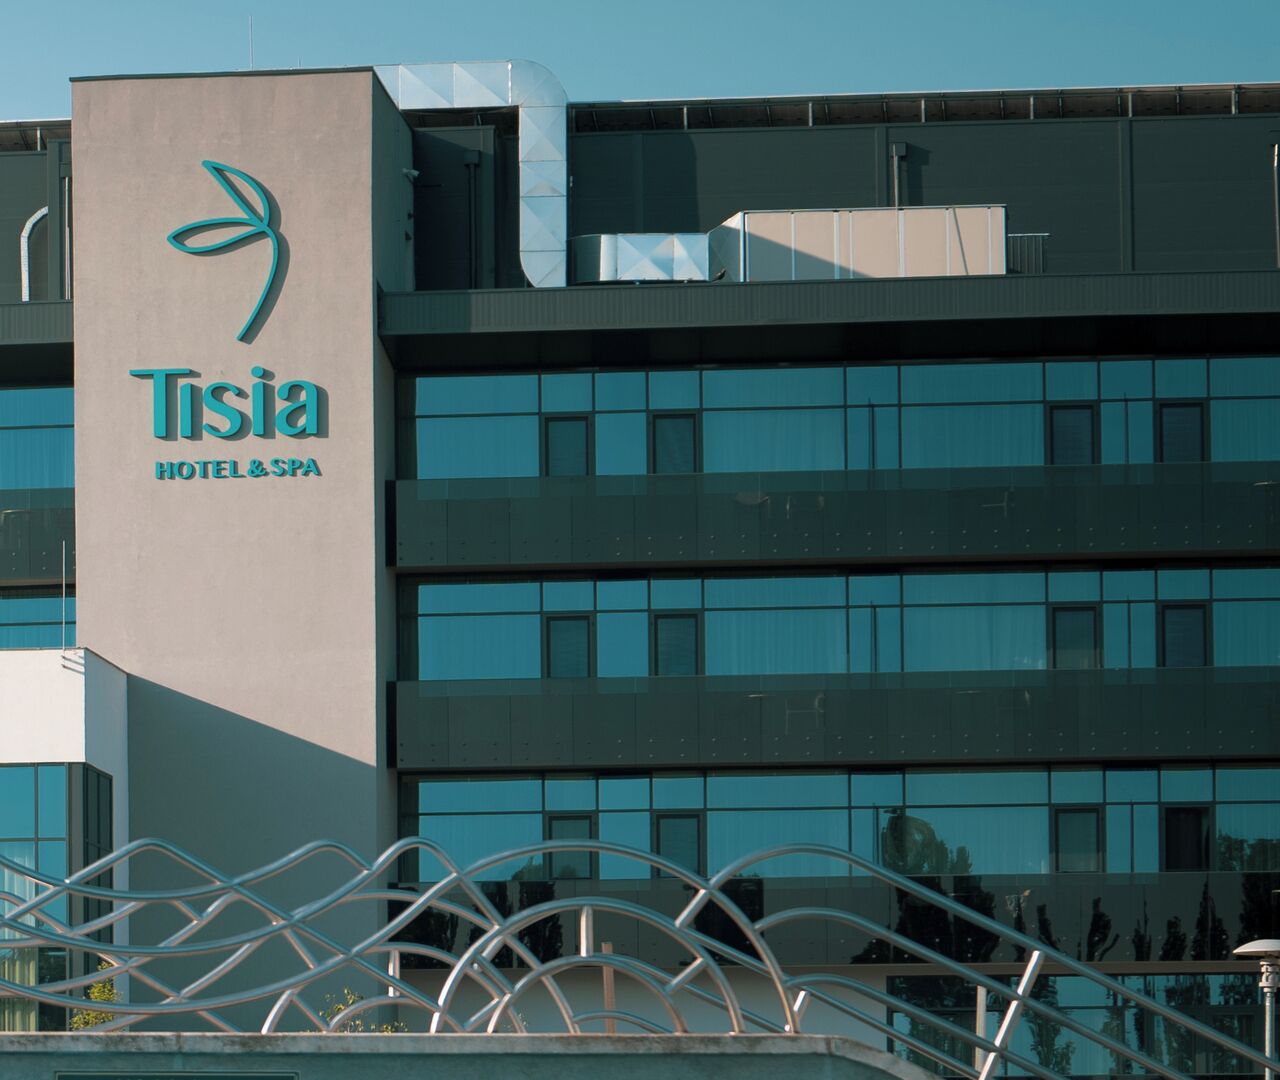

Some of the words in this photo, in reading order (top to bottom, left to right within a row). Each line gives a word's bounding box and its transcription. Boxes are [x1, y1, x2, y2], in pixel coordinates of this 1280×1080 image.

[129, 365, 320, 438] Tisia
[155, 459, 242, 480] HOTEL
[270, 457, 322, 477] SPA
